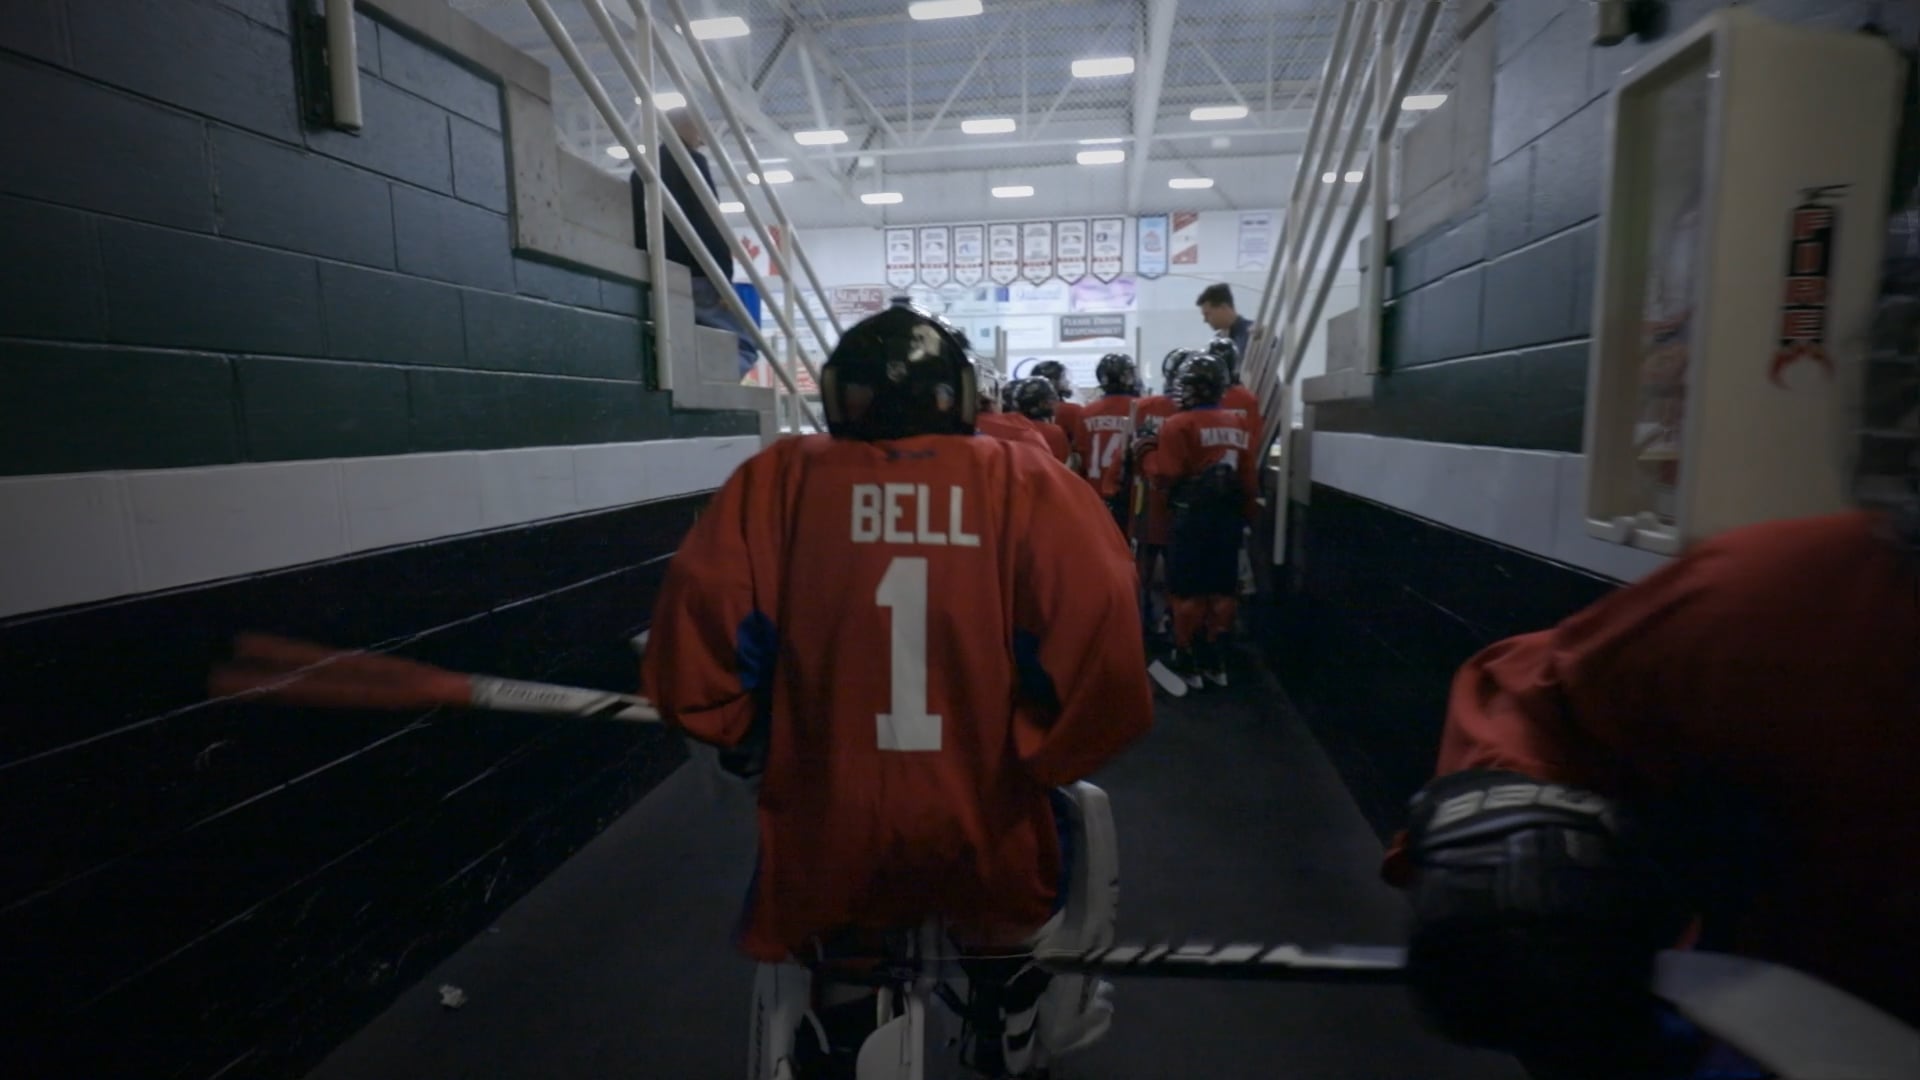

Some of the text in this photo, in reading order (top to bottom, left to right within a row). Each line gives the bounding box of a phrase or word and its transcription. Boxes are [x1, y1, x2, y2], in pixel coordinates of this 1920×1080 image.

[1782, 210, 1832, 339] FIRE
[851, 483, 981, 547] BELL
[875, 556, 942, 751] 1
